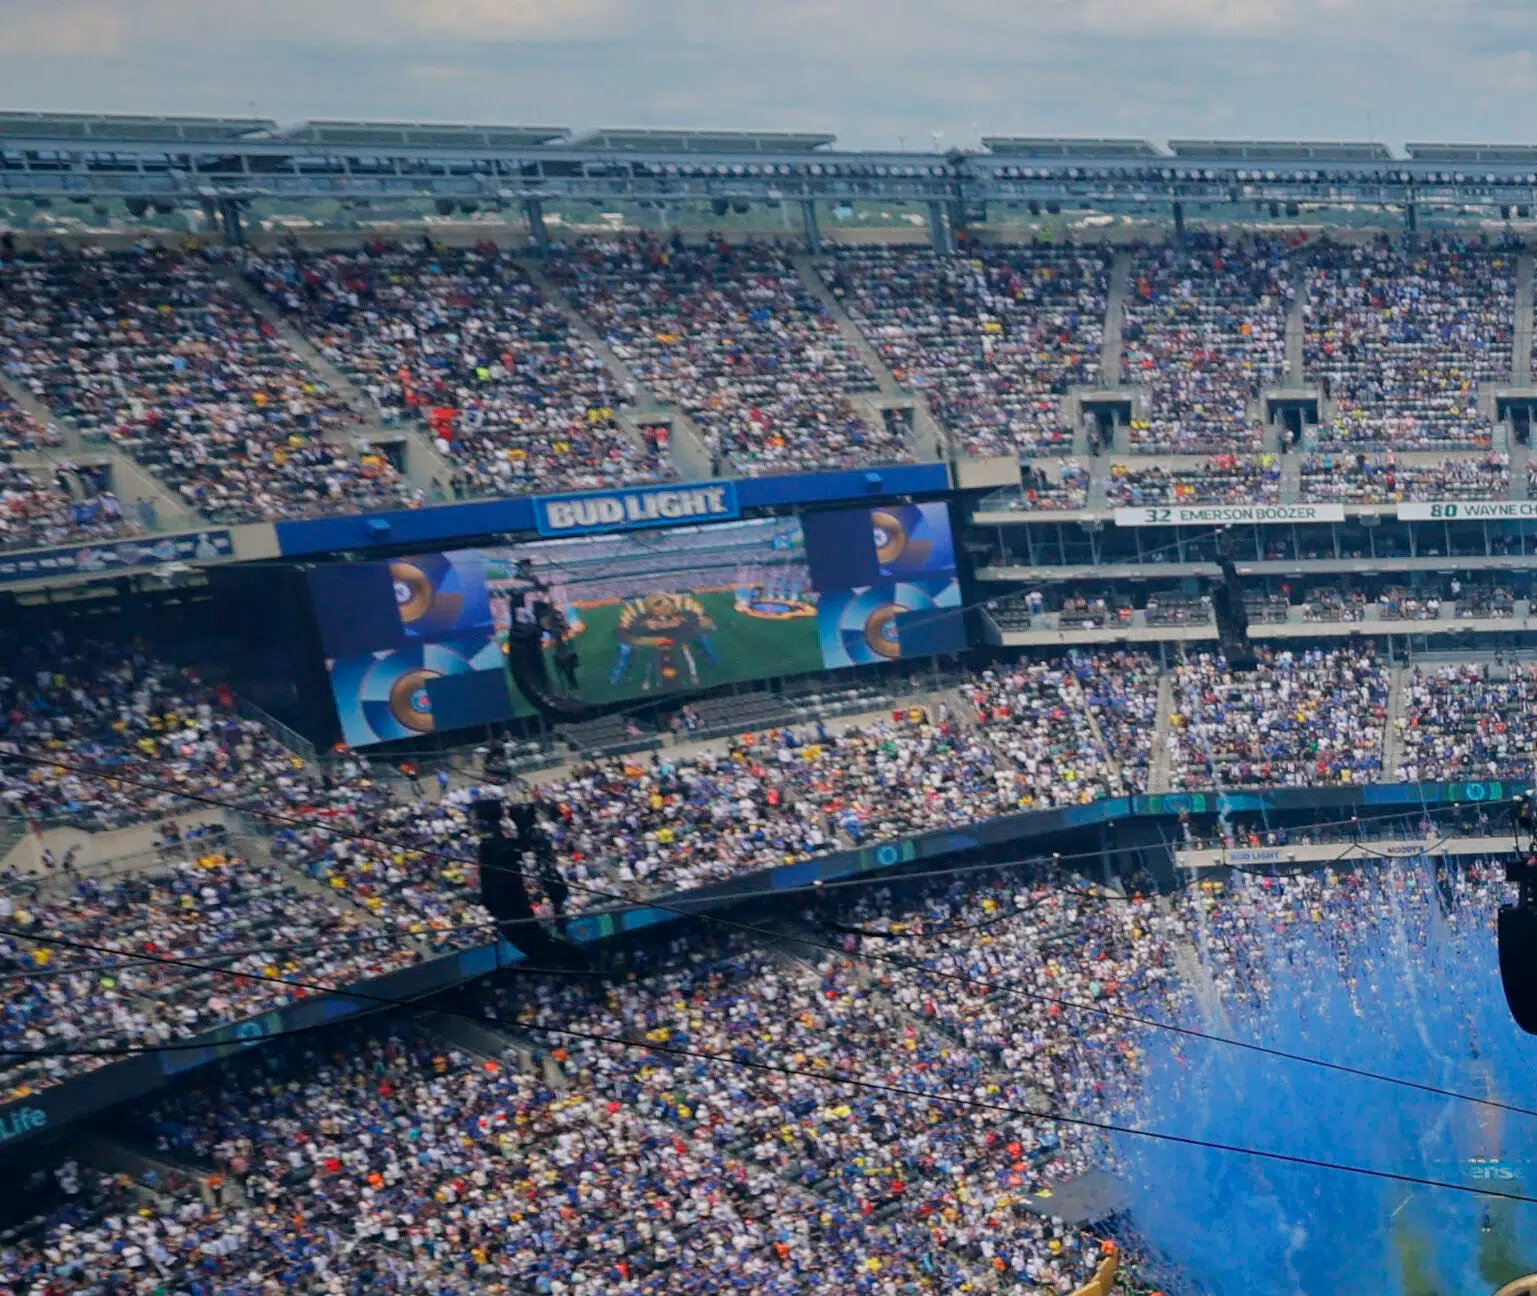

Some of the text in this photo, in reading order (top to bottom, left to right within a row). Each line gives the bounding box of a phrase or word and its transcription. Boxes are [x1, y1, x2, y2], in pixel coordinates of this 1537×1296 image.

[546, 486, 728, 528] BUD LIGHT
[1145, 507, 1316, 522] 32 EMERSON BOOZER
[1430, 504, 1457, 517] 80
[1464, 504, 1517, 516] WAYNE
